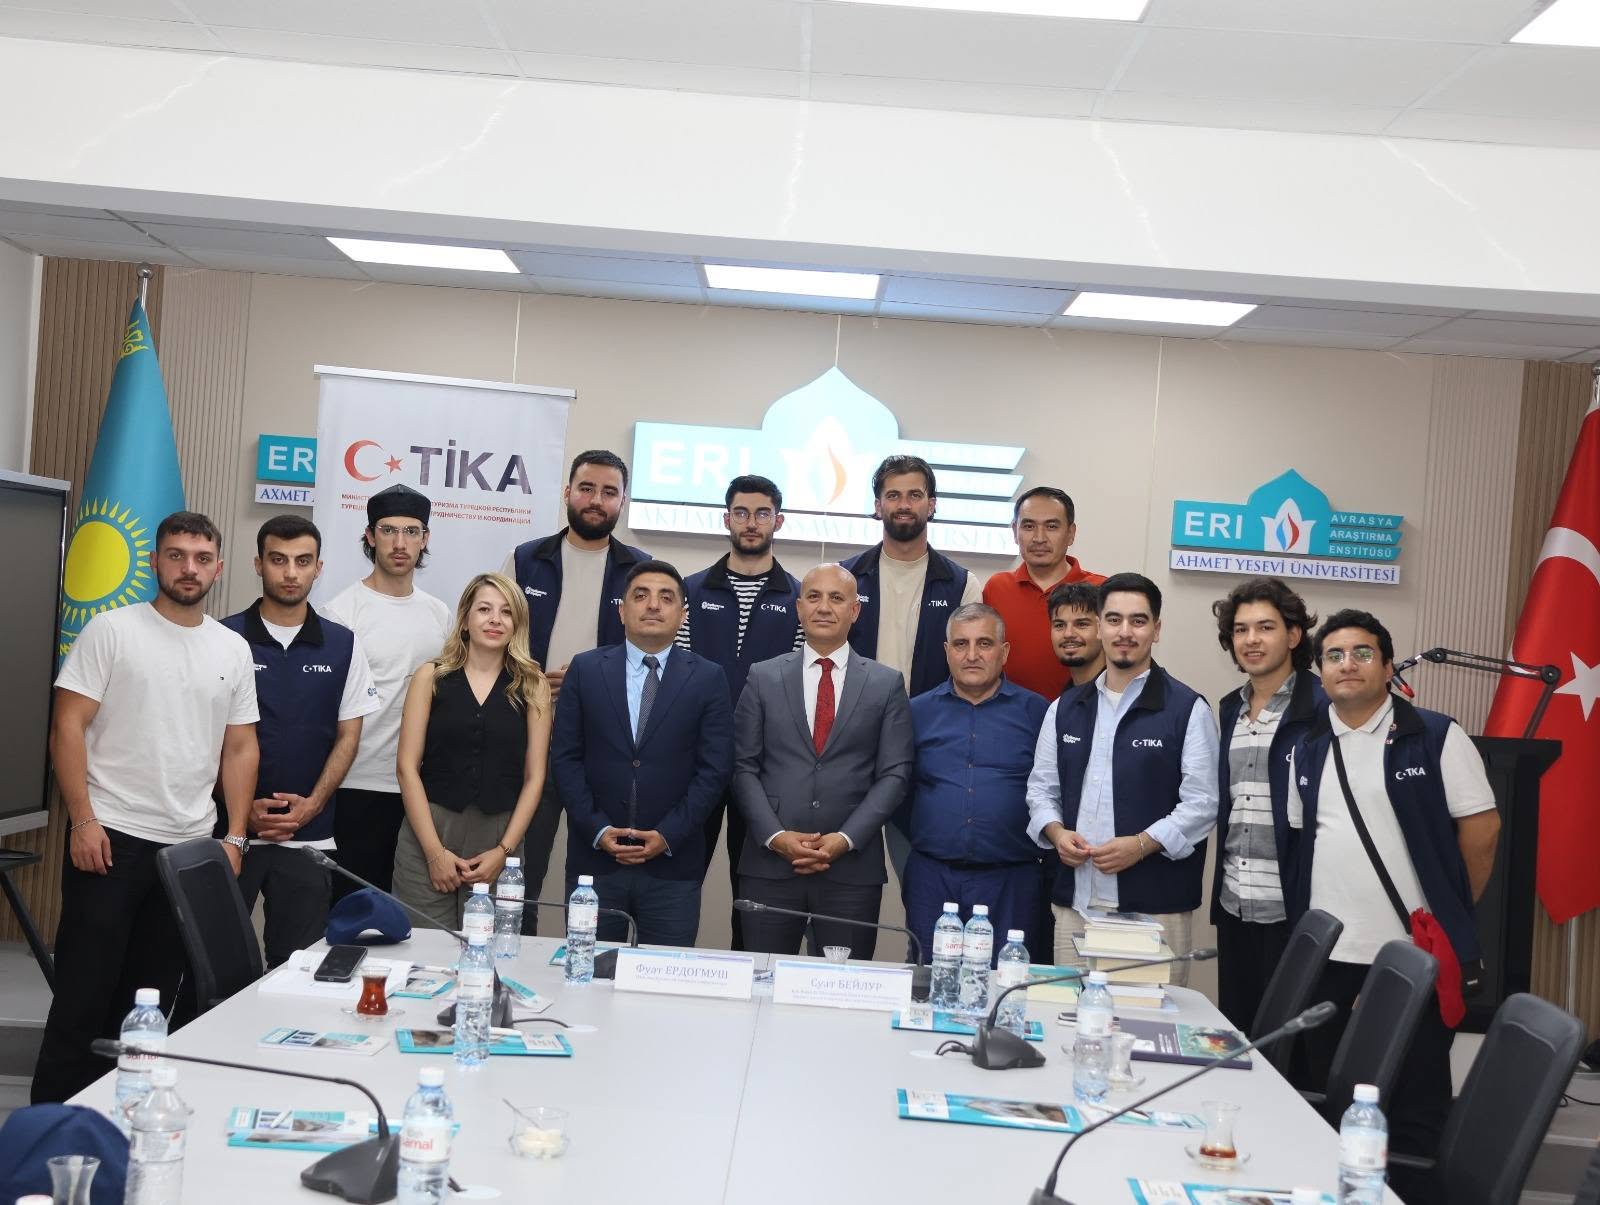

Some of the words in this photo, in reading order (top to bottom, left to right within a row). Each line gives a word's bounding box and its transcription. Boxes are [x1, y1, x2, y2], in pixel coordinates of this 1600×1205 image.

[268, 445, 314, 473] ER
[410, 440, 532, 494] TİKA
[1184, 511, 1243, 540] ERI
[1331, 514, 1393, 527] AVRASYA
[1330, 529, 1393, 542] ARAŞTIRMA
[1329, 544, 1392, 558] ENSTİTÜSÜ
[1176, 554, 1232, 570] AHMET
[1236, 558, 1285, 574] YESEVİ
[1291, 560, 1396, 582] ÜNİVERSİTESİ
